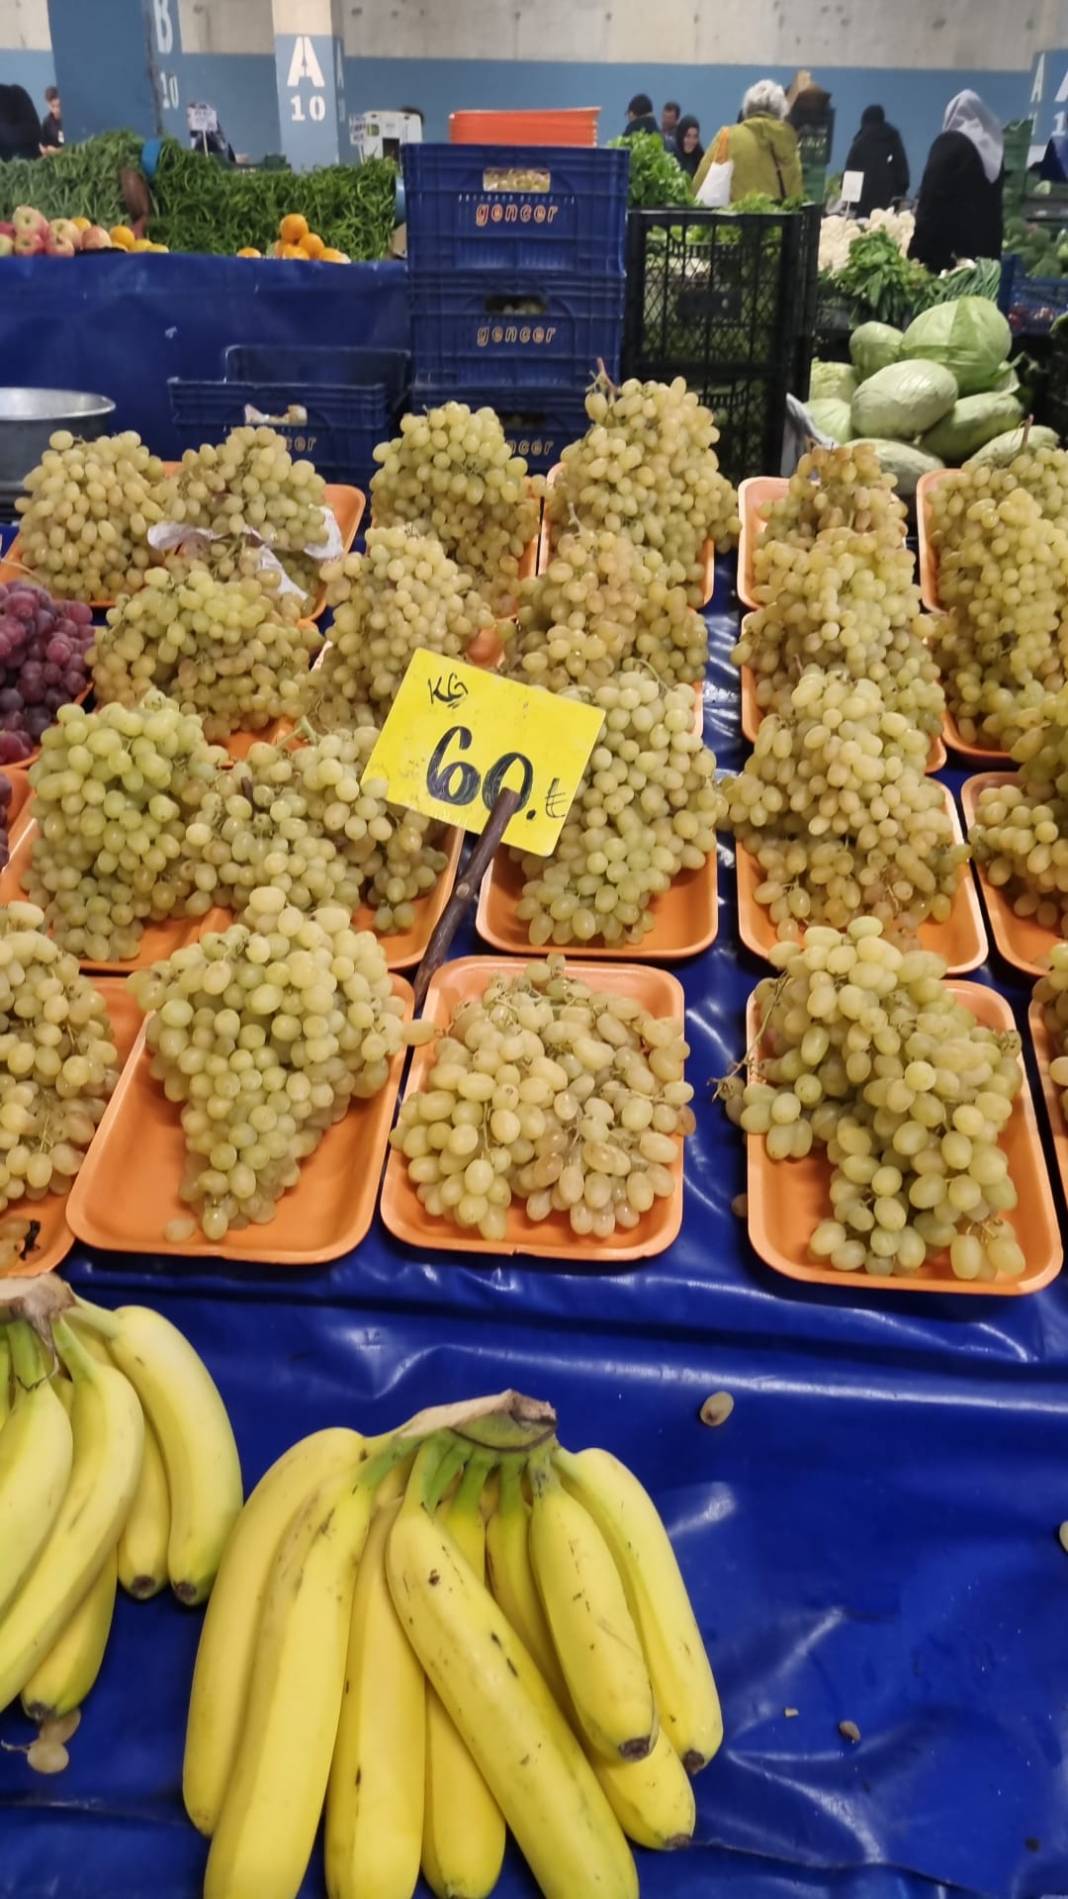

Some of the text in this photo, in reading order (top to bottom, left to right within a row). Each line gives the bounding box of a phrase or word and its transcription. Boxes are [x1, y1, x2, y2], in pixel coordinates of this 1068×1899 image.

[287, 36, 325, 87] A
[160, 71, 179, 109] 10
[290, 95, 326, 121] 10
[475, 203, 558, 227] gencer
[477, 326, 556, 347] gencer
[427, 672, 469, 706] KG
